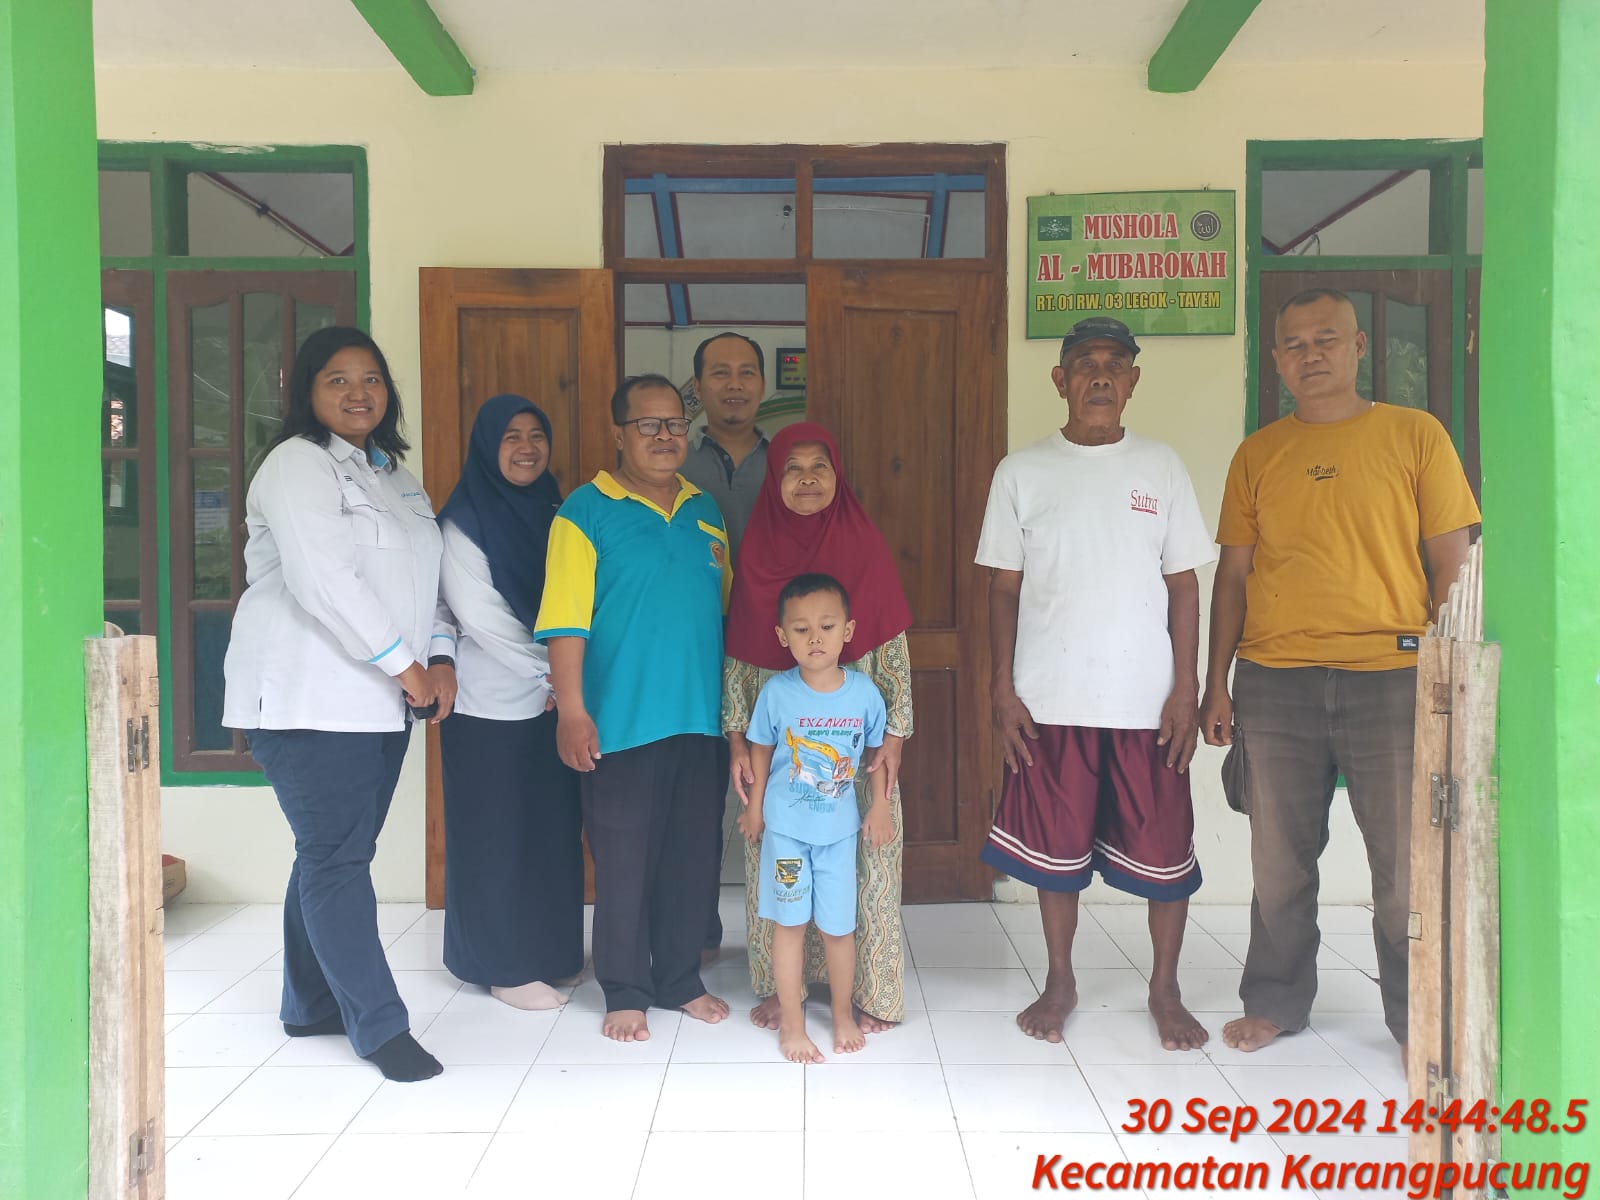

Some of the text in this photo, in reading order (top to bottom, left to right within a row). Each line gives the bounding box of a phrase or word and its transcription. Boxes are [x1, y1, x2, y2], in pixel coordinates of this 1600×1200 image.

[1084, 213, 1178, 240] MUSHOLA
[1037, 255, 1064, 281] AL
[1087, 251, 1227, 280] MUBAROKAH
[1035, 294, 1056, 311] RT.
[1058, 294, 1074, 311] 01
[1076, 293, 1102, 310] RW.
[1104, 293, 1123, 309] 03
[1125, 292, 1168, 309] LEGOK
[1177, 291, 1221, 308] TAYEM
[1130, 489, 1158, 511] Sutra
